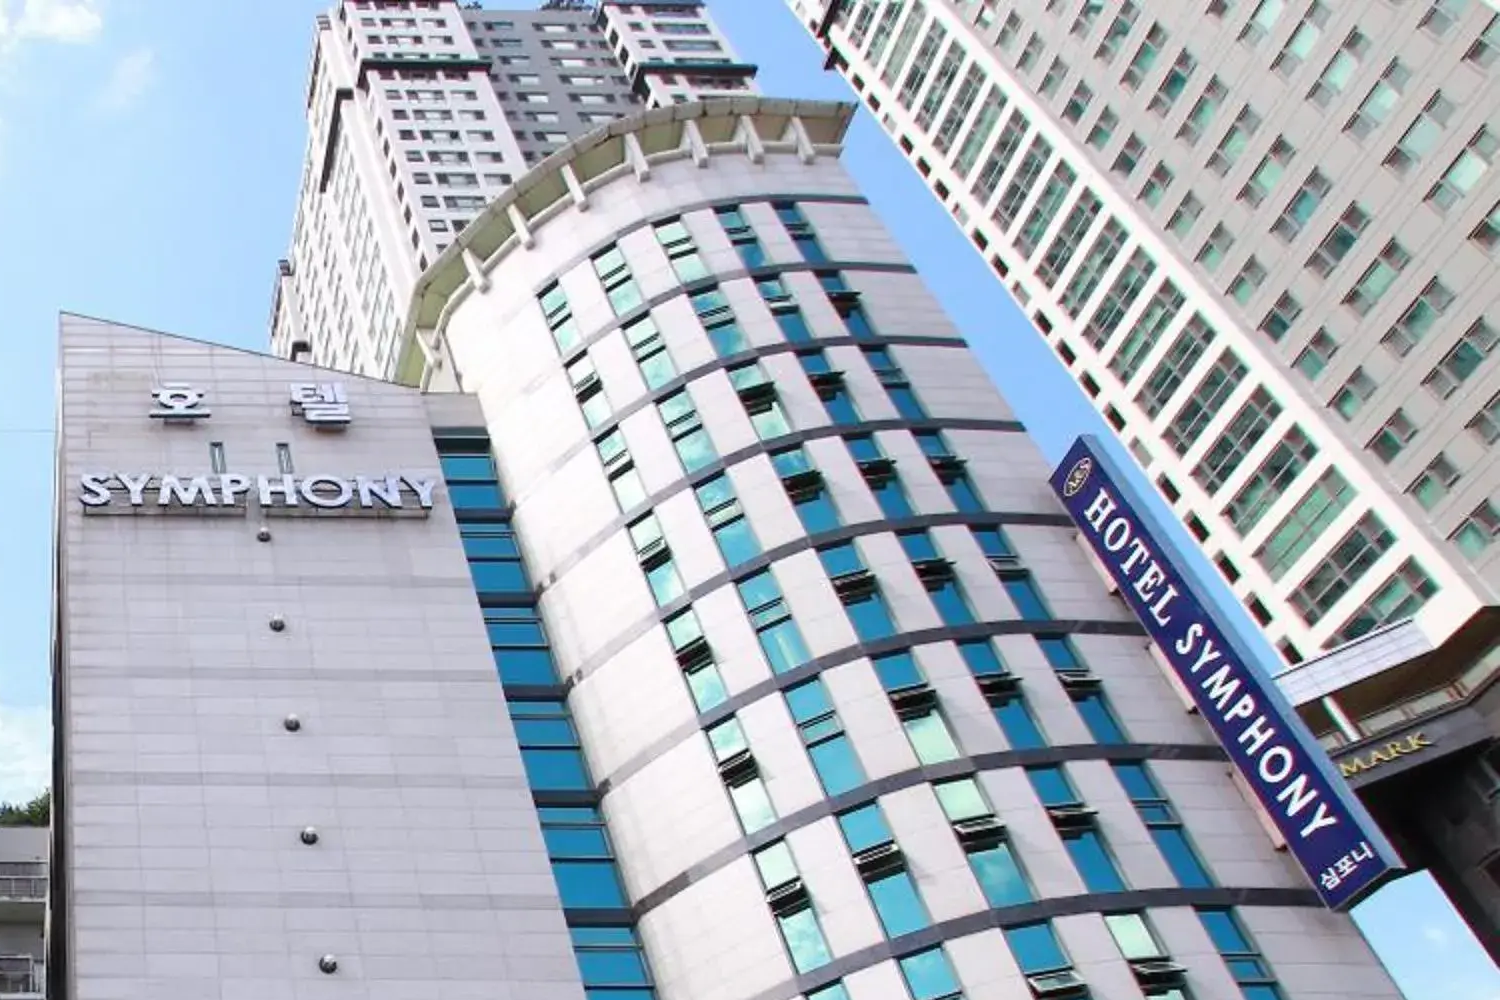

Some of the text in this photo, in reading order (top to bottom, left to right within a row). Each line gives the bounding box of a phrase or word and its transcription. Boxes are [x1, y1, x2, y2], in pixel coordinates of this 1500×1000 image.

[79, 472, 437, 510] SYMPHONY
[1083, 487, 1338, 839] HOTEL SYMPHONY
[1338, 731, 1433, 778] MARK
[1319, 841, 1376, 892] 심포니
